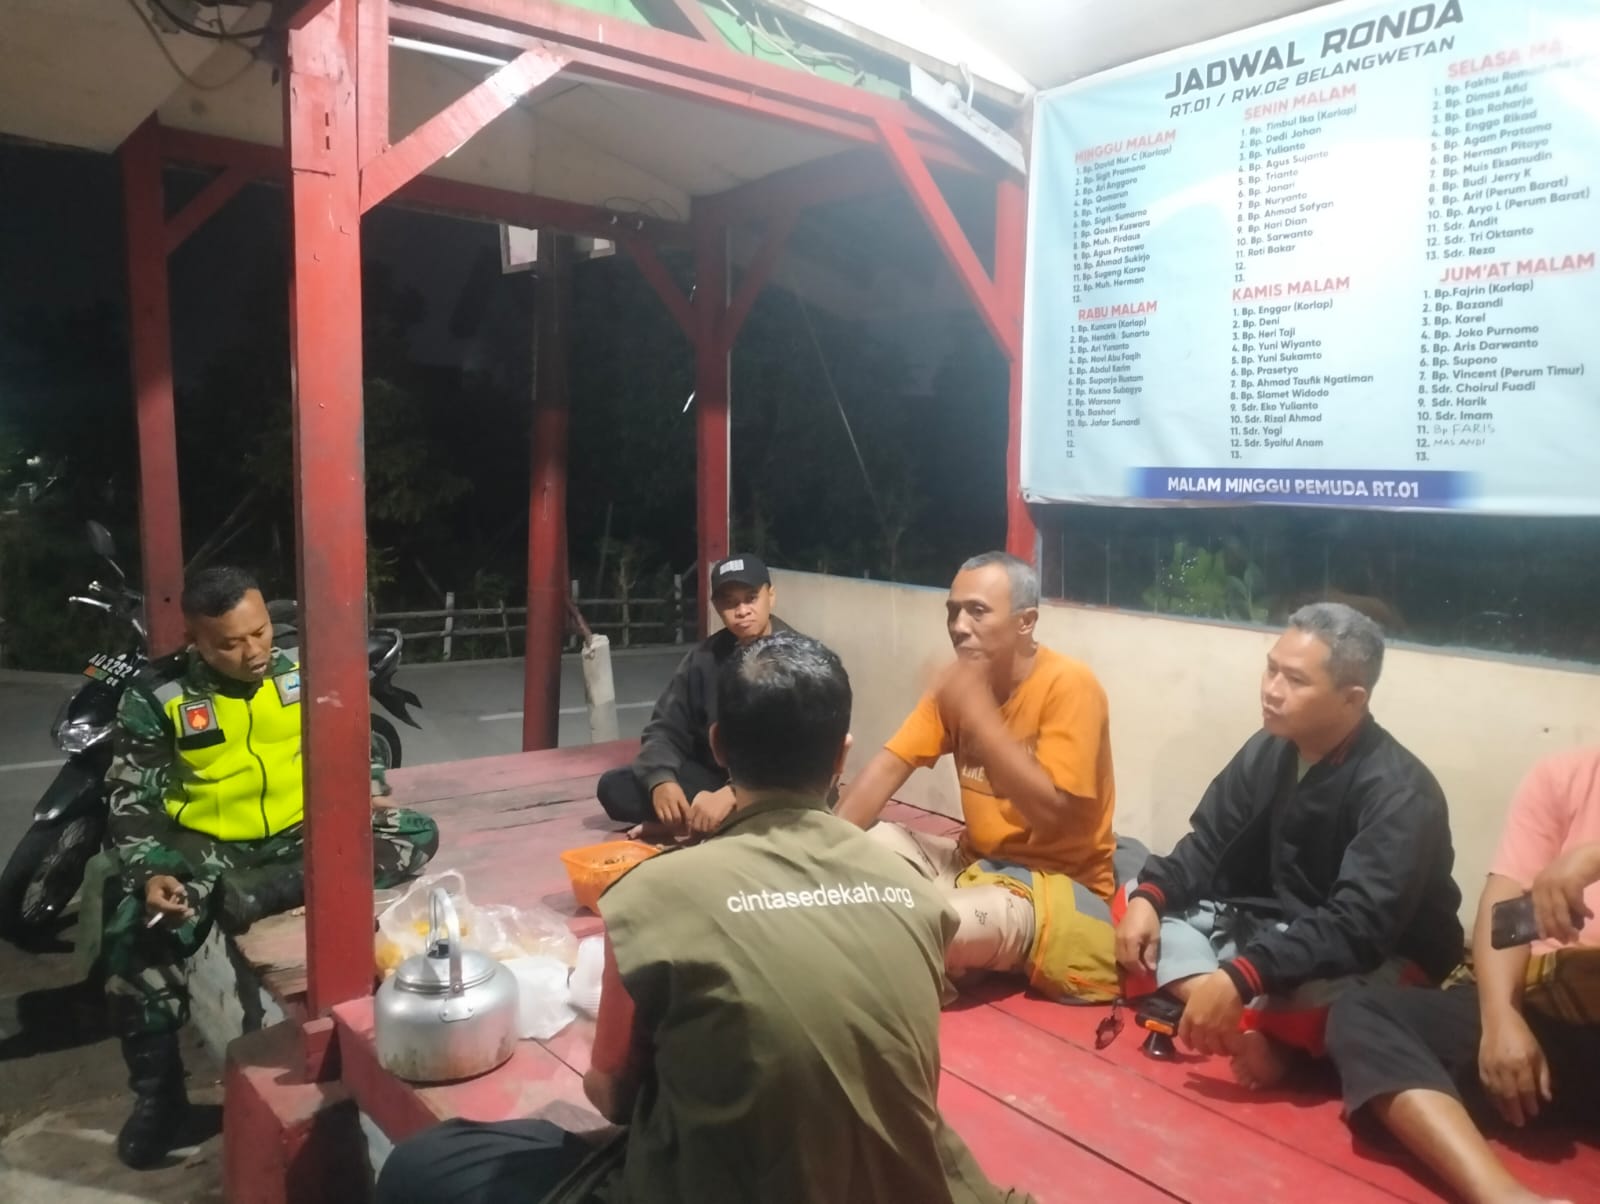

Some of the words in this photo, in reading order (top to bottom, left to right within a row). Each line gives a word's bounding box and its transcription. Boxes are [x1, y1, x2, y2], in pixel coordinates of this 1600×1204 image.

[1165, 42, 1305, 99] JADWAL
[1321, 0, 1463, 58] RONDA
[1447, 50, 1521, 78] SELASA
[1170, 98, 1210, 118] RT.01
[1232, 78, 1288, 103] RW.02
[1296, 36, 1454, 86] BELANGWETAN
[1244, 100, 1288, 121] SENIN
[1293, 84, 1357, 108] MALAM
[1075, 143, 1122, 164] MINGGU
[1126, 130, 1176, 150] MALAM
[1266, 159, 1289, 169] Agus
[1463, 177, 1487, 188] Budi
[1285, 218, 1307, 226] Dian
[1470, 233, 1482, 243] Tri
[1486, 227, 1533, 240] Oktanto
[1440, 262, 1511, 282] JUM'AT
[1517, 253, 1595, 275] MALAM
[1232, 284, 1282, 301] KAMIS
[1288, 277, 1350, 294] MALAM
[1489, 280, 1534, 294] (Korlap)
[1079, 309, 1108, 320] RABU
[1112, 301, 1157, 316] MALAM
[1259, 317, 1279, 326] Deni
[1455, 313, 1486, 324] Karel
[1456, 328, 1483, 338] Joko
[1487, 326, 1539, 336] Purnomo
[1259, 341, 1278, 350] Yuni
[1281, 339, 1321, 350] Wiyanto
[1453, 342, 1476, 352] Aris
[1480, 339, 1539, 351] Darwanto
[1258, 354, 1277, 363] Yuni
[1257, 366, 1298, 376] Prasetyo
[1432, 371, 1449, 381] Bp.
[1453, 369, 1497, 379] Vincent
[1501, 366, 1543, 379] (Perum
[1547, 364, 1584, 376] Timur)
[1257, 378, 1290, 387] Ahmad
[1324, 374, 1373, 385] Ngatiman
[1292, 388, 1329, 398] Widodo
[1432, 384, 1453, 394] Sdr.
[1456, 382, 1498, 393] Choirul
[1502, 381, 1535, 391] Fuadi
[1432, 398, 1453, 407] Sdr.
[1456, 397, 1487, 406] Harik
[1289, 413, 1322, 422] Ahmad
[1436, 411, 1456, 420] Sdr.
[1460, 411, 1492, 420] Imam
[1263, 426, 1282, 436] Yogi
[1453, 423, 1495, 435] FARIS
[1296, 439, 1323, 447] Anam
[1167, 477, 1220, 492] MALAM
[1225, 478, 1290, 493] MINGGU
[1295, 480, 1368, 496] PEMUDA
[1373, 481, 1419, 498] RT.01
[727, 882, 915, 912] cintasedekah.org
